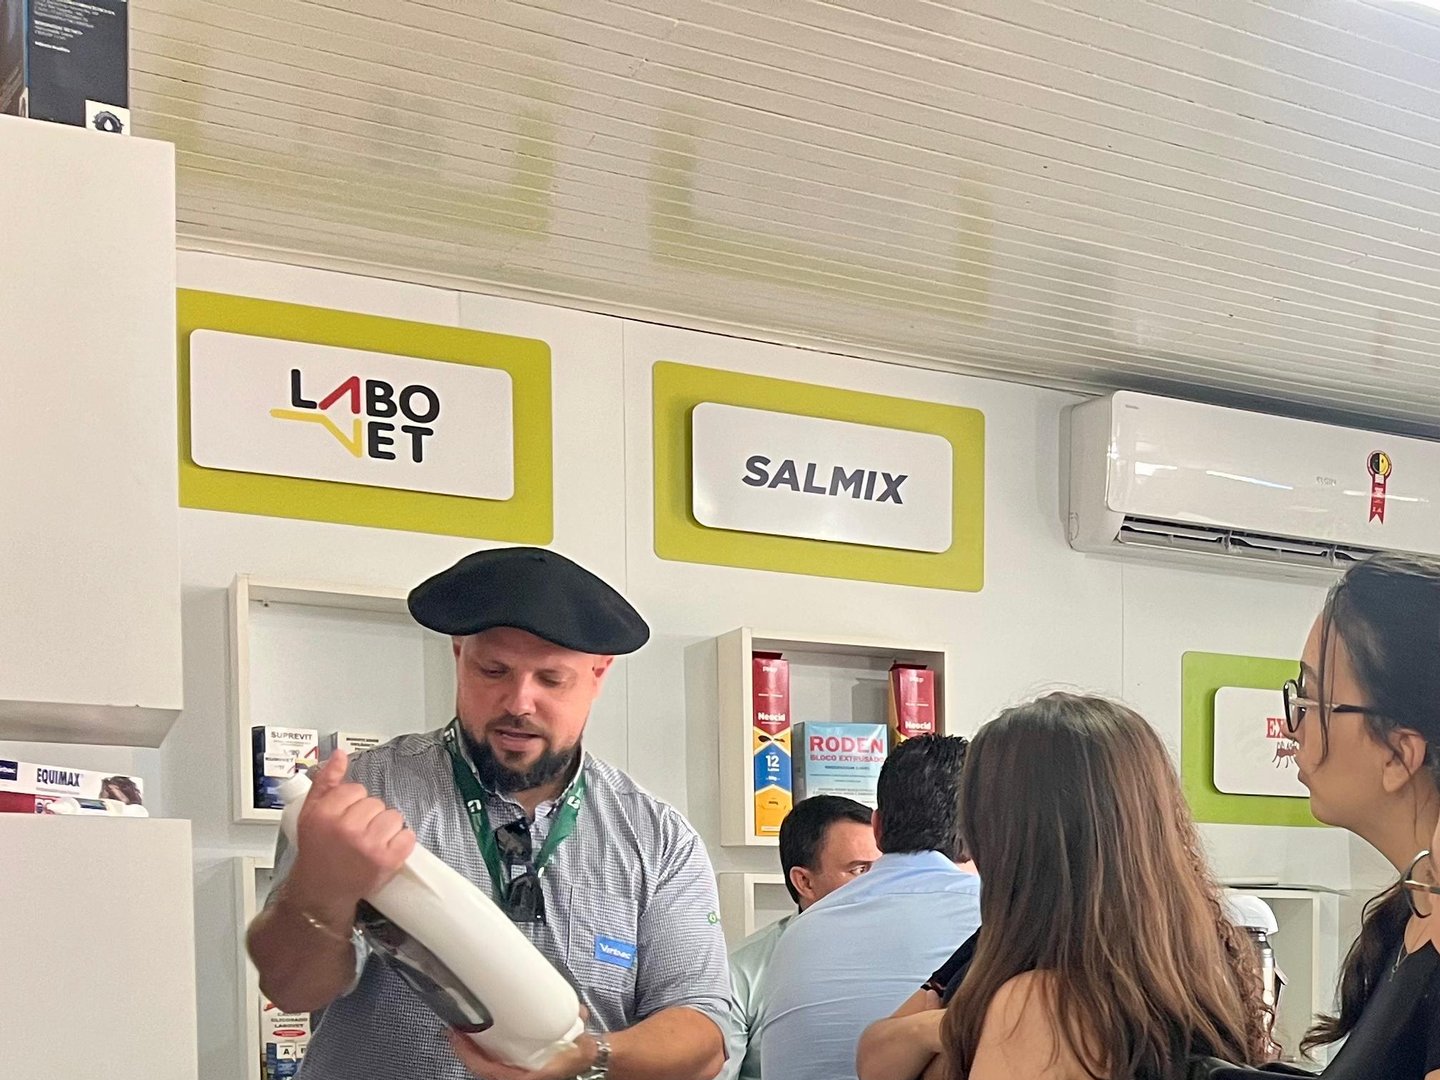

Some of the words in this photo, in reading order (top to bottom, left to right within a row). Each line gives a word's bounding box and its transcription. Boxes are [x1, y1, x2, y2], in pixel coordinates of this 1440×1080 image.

[291, 369, 440, 423] LABO
[269, 408, 434, 463] VET
[742, 455, 908, 505] SALMIX
[758, 711, 785, 721] Neocid
[271, 731, 312, 741] SUPREVIT
[810, 736, 884, 753] RODEN
[766, 755, 780, 767] 12
[839, 755, 885, 763] EXTRUSADO
[37, 768, 80, 787] EQUIMAX
